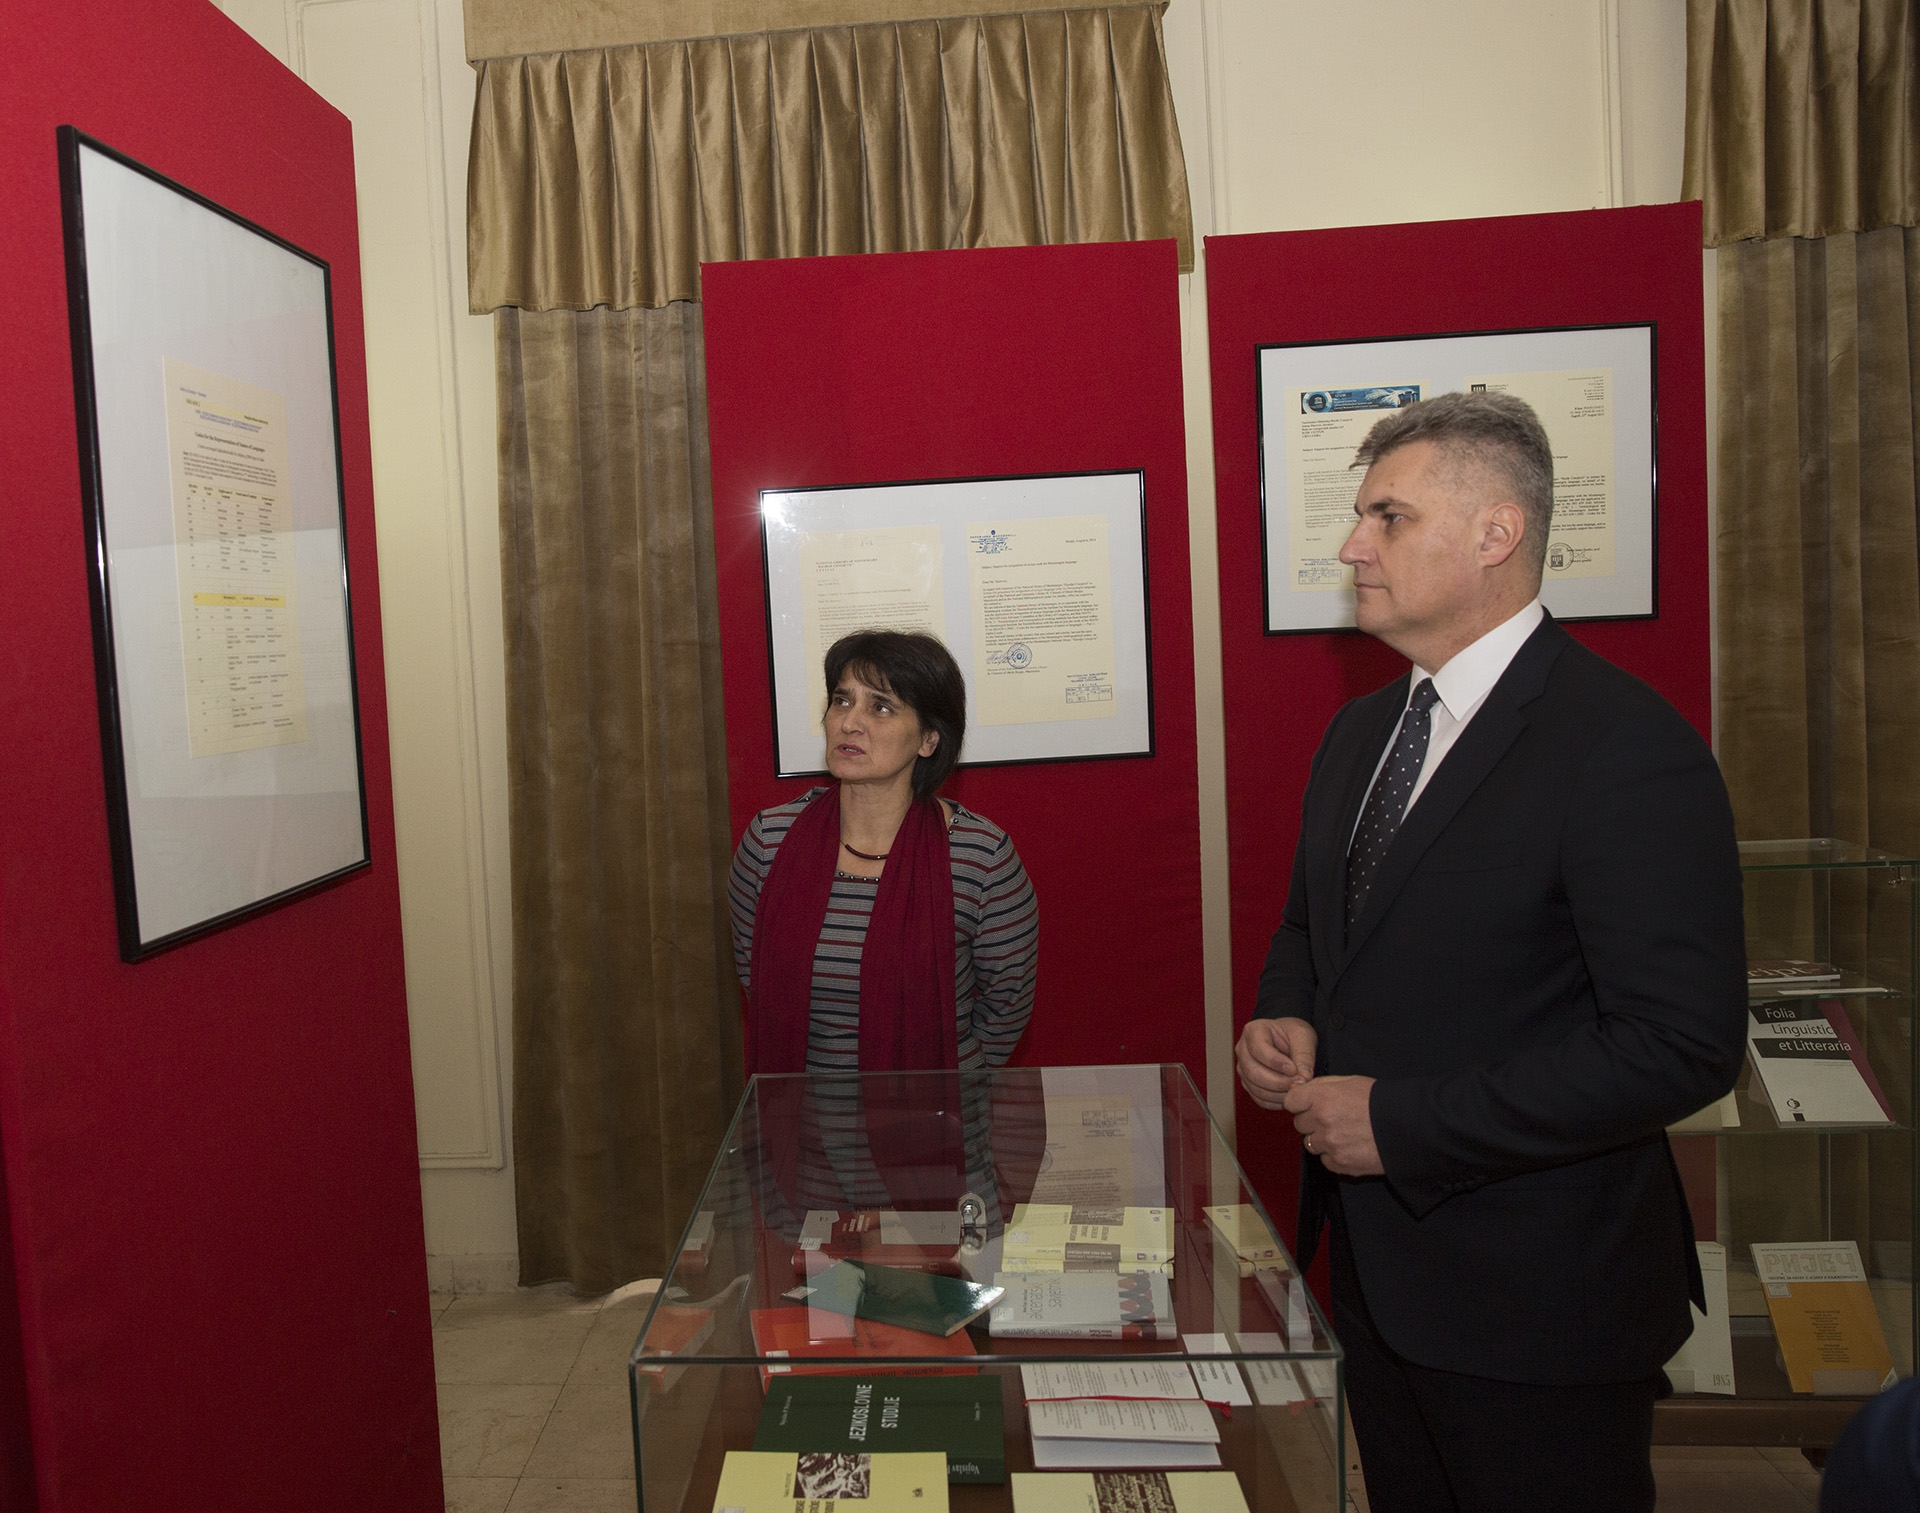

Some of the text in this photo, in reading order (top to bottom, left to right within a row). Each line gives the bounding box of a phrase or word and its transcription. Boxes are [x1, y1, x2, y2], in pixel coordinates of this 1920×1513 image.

[1765, 1007, 1796, 1019] Folia
[1779, 1040, 1852, 1051] et Litteraria
[1761, 1252, 1856, 1273] РИЈЕЧ
[1001, 1327, 1037, 1338] savjetnik
[848, 1384, 873, 1442] JEZIKOSLOVNE
[880, 1396, 901, 1429] STUDIJE
[951, 1462, 980, 1475] Vojislav
